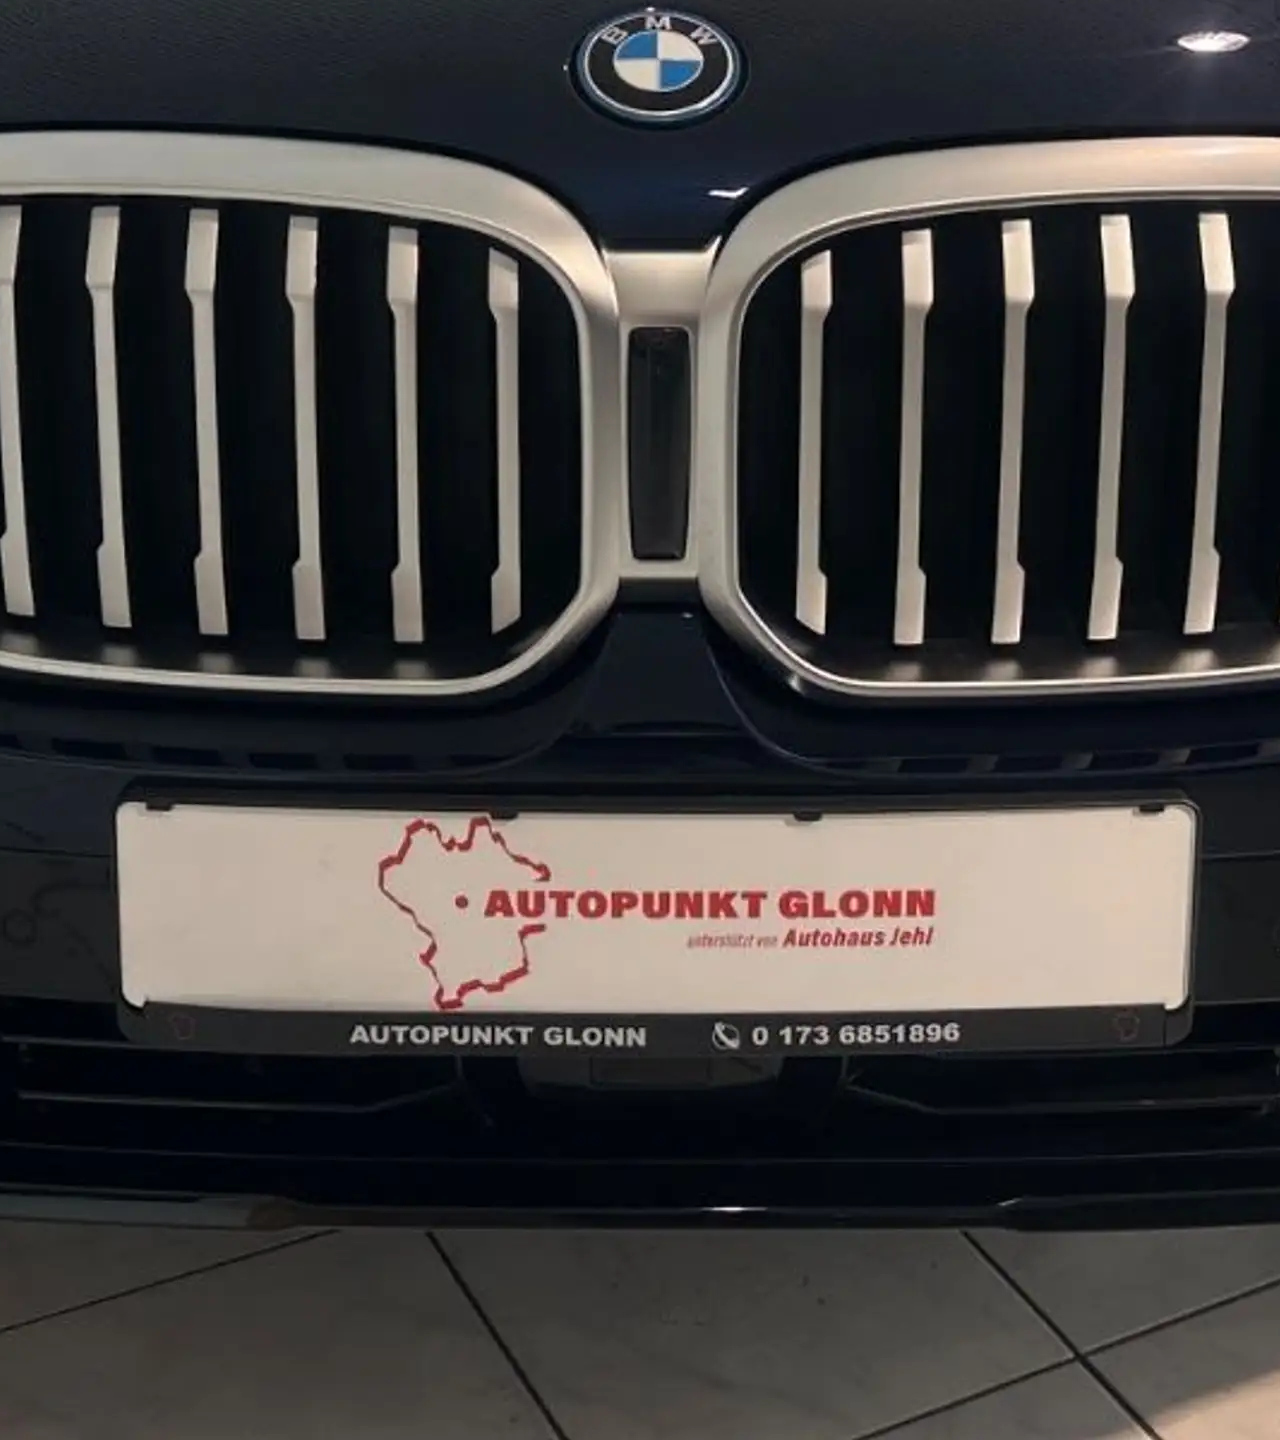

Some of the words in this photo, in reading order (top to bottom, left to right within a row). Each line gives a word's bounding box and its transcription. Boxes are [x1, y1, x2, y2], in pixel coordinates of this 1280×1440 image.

[600, 16, 718, 45] BMW
[483, 890, 767, 918] AUTOPUNKT
[777, 889, 936, 918] GLONN
[782, 927, 886, 948] Autohaus
[889, 926, 935, 947] Jehl
[349, 1024, 534, 1045] AUTOPUNKT
[543, 1026, 647, 1047] GLONN
[752, 1027, 769, 1046] 0
[778, 1026, 829, 1045] 173
[839, 1022, 961, 1044] 6851896
